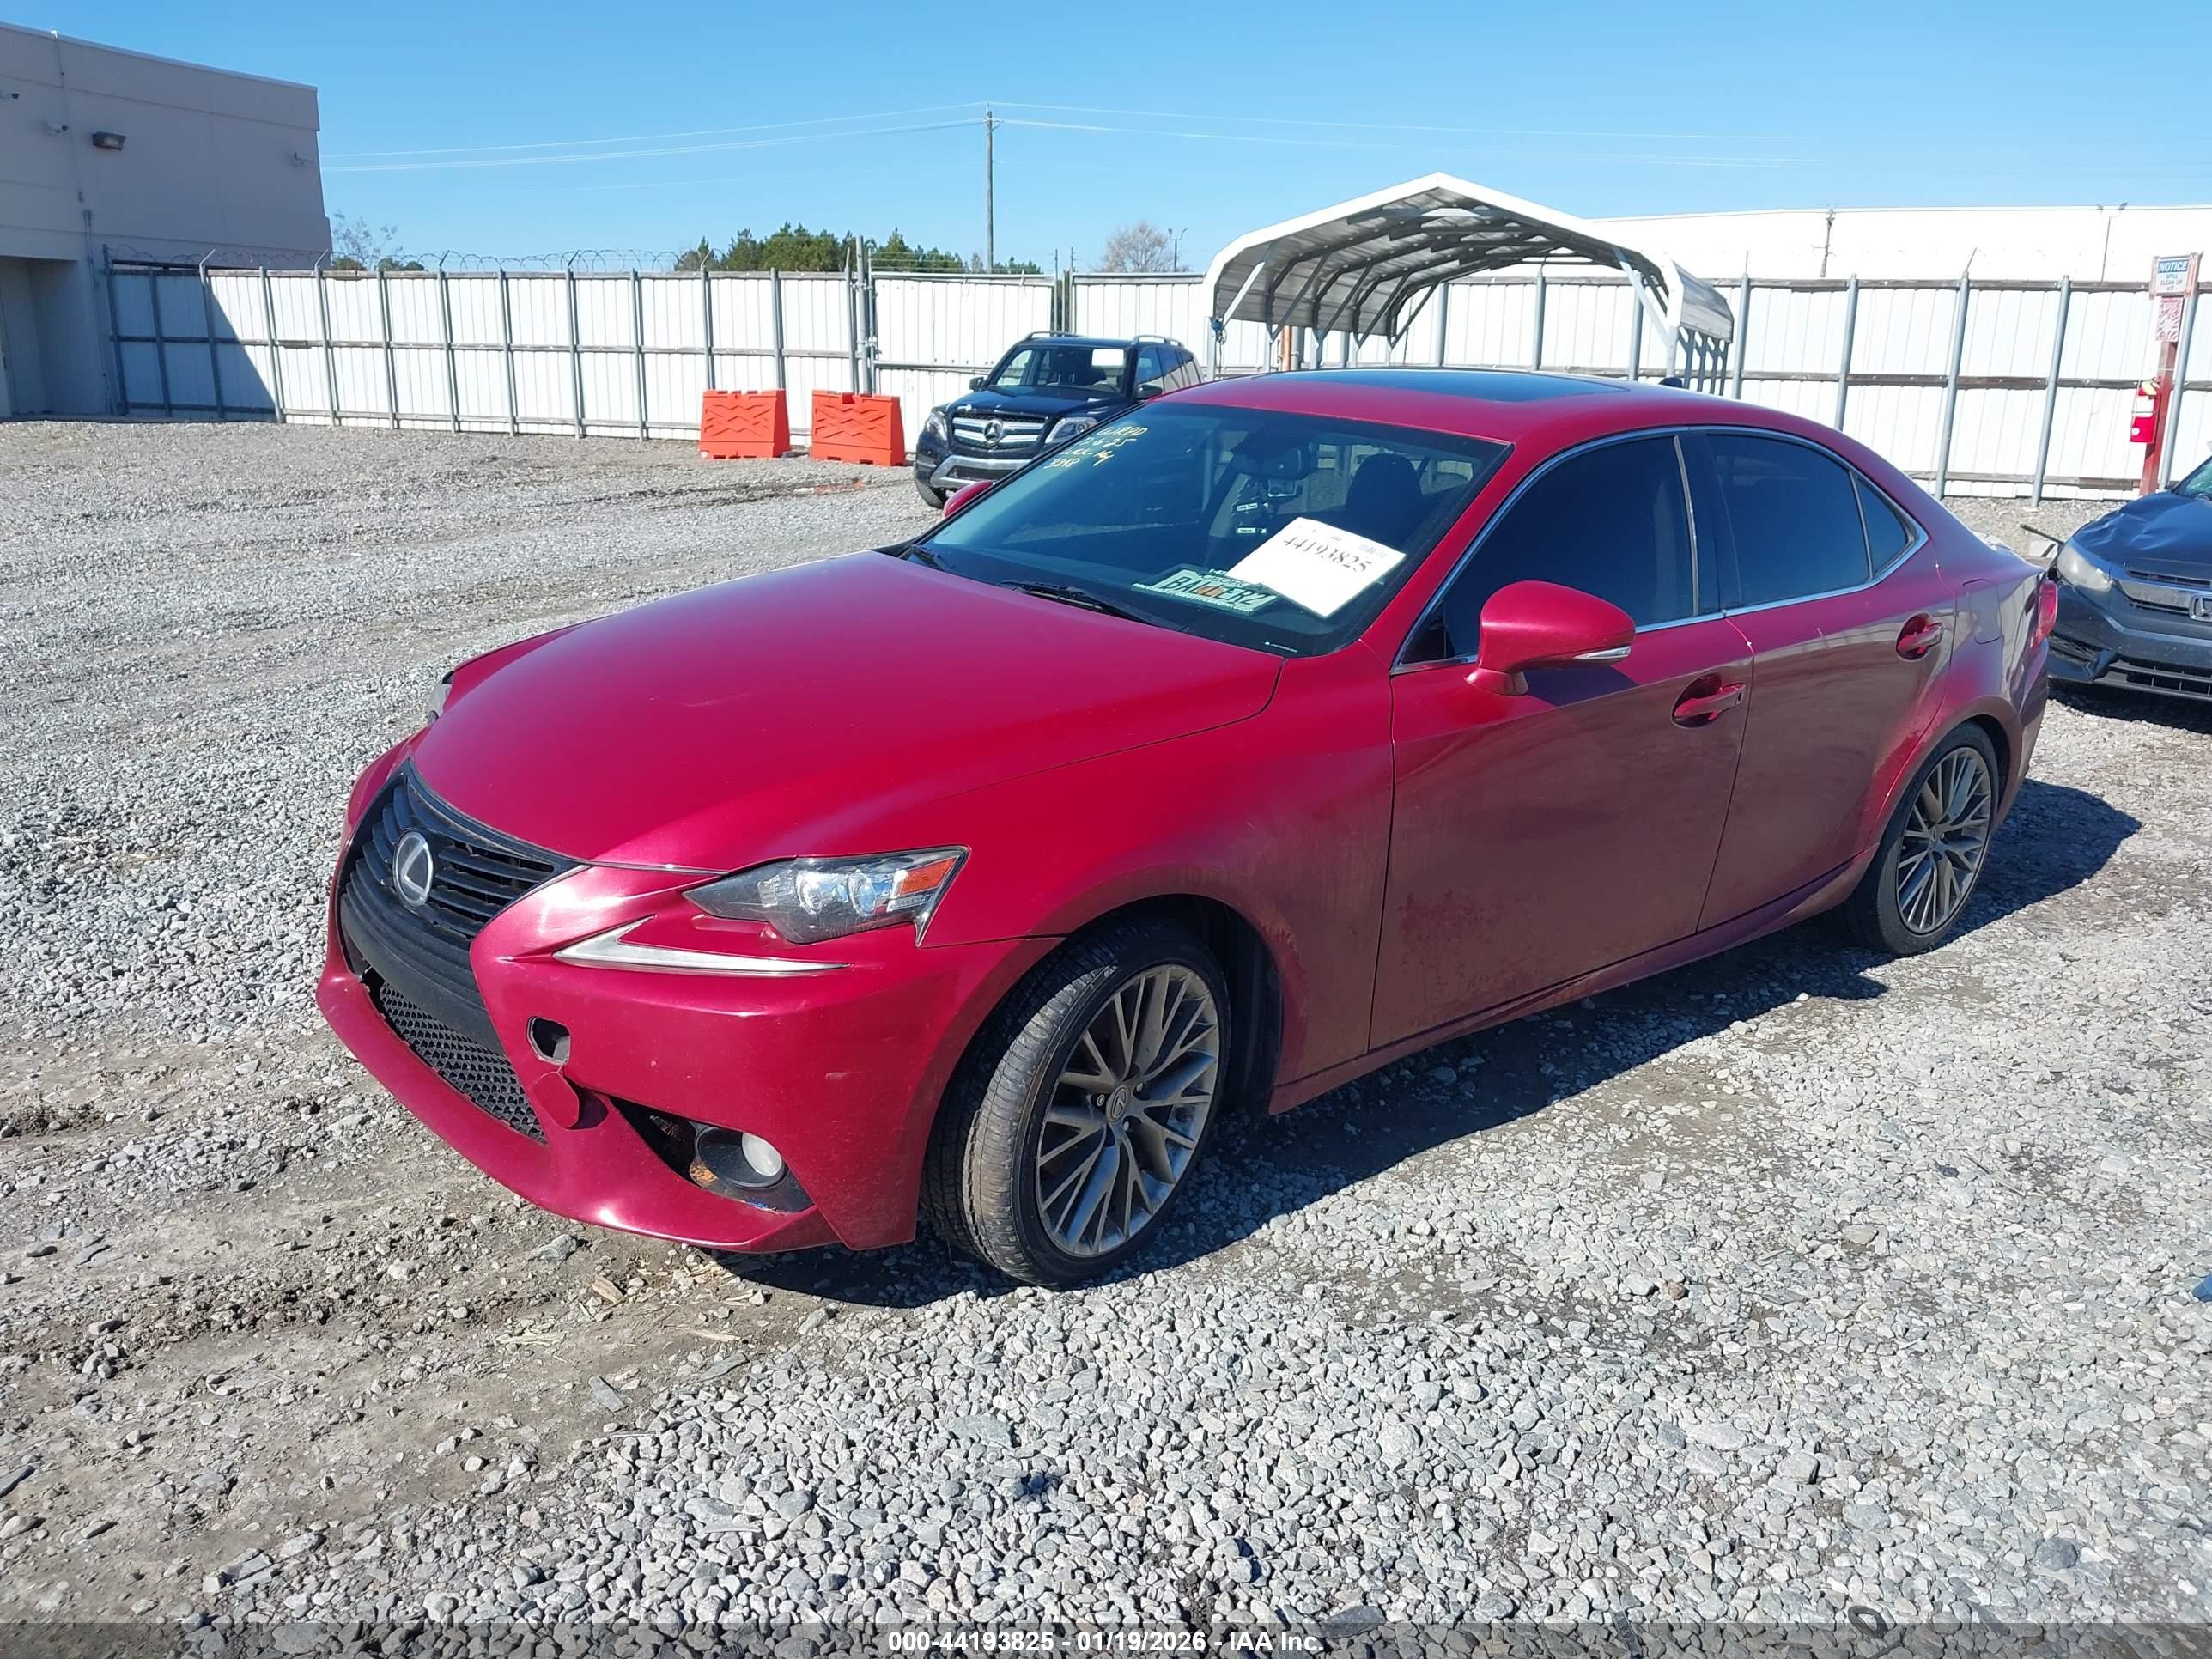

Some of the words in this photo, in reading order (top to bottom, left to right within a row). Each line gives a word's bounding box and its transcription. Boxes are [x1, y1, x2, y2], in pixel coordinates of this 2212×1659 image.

[2158, 260, 2188, 272] NOTICE
[1284, 536, 1372, 571] 44193825
[1163, 576, 1269, 605] BALLER2
